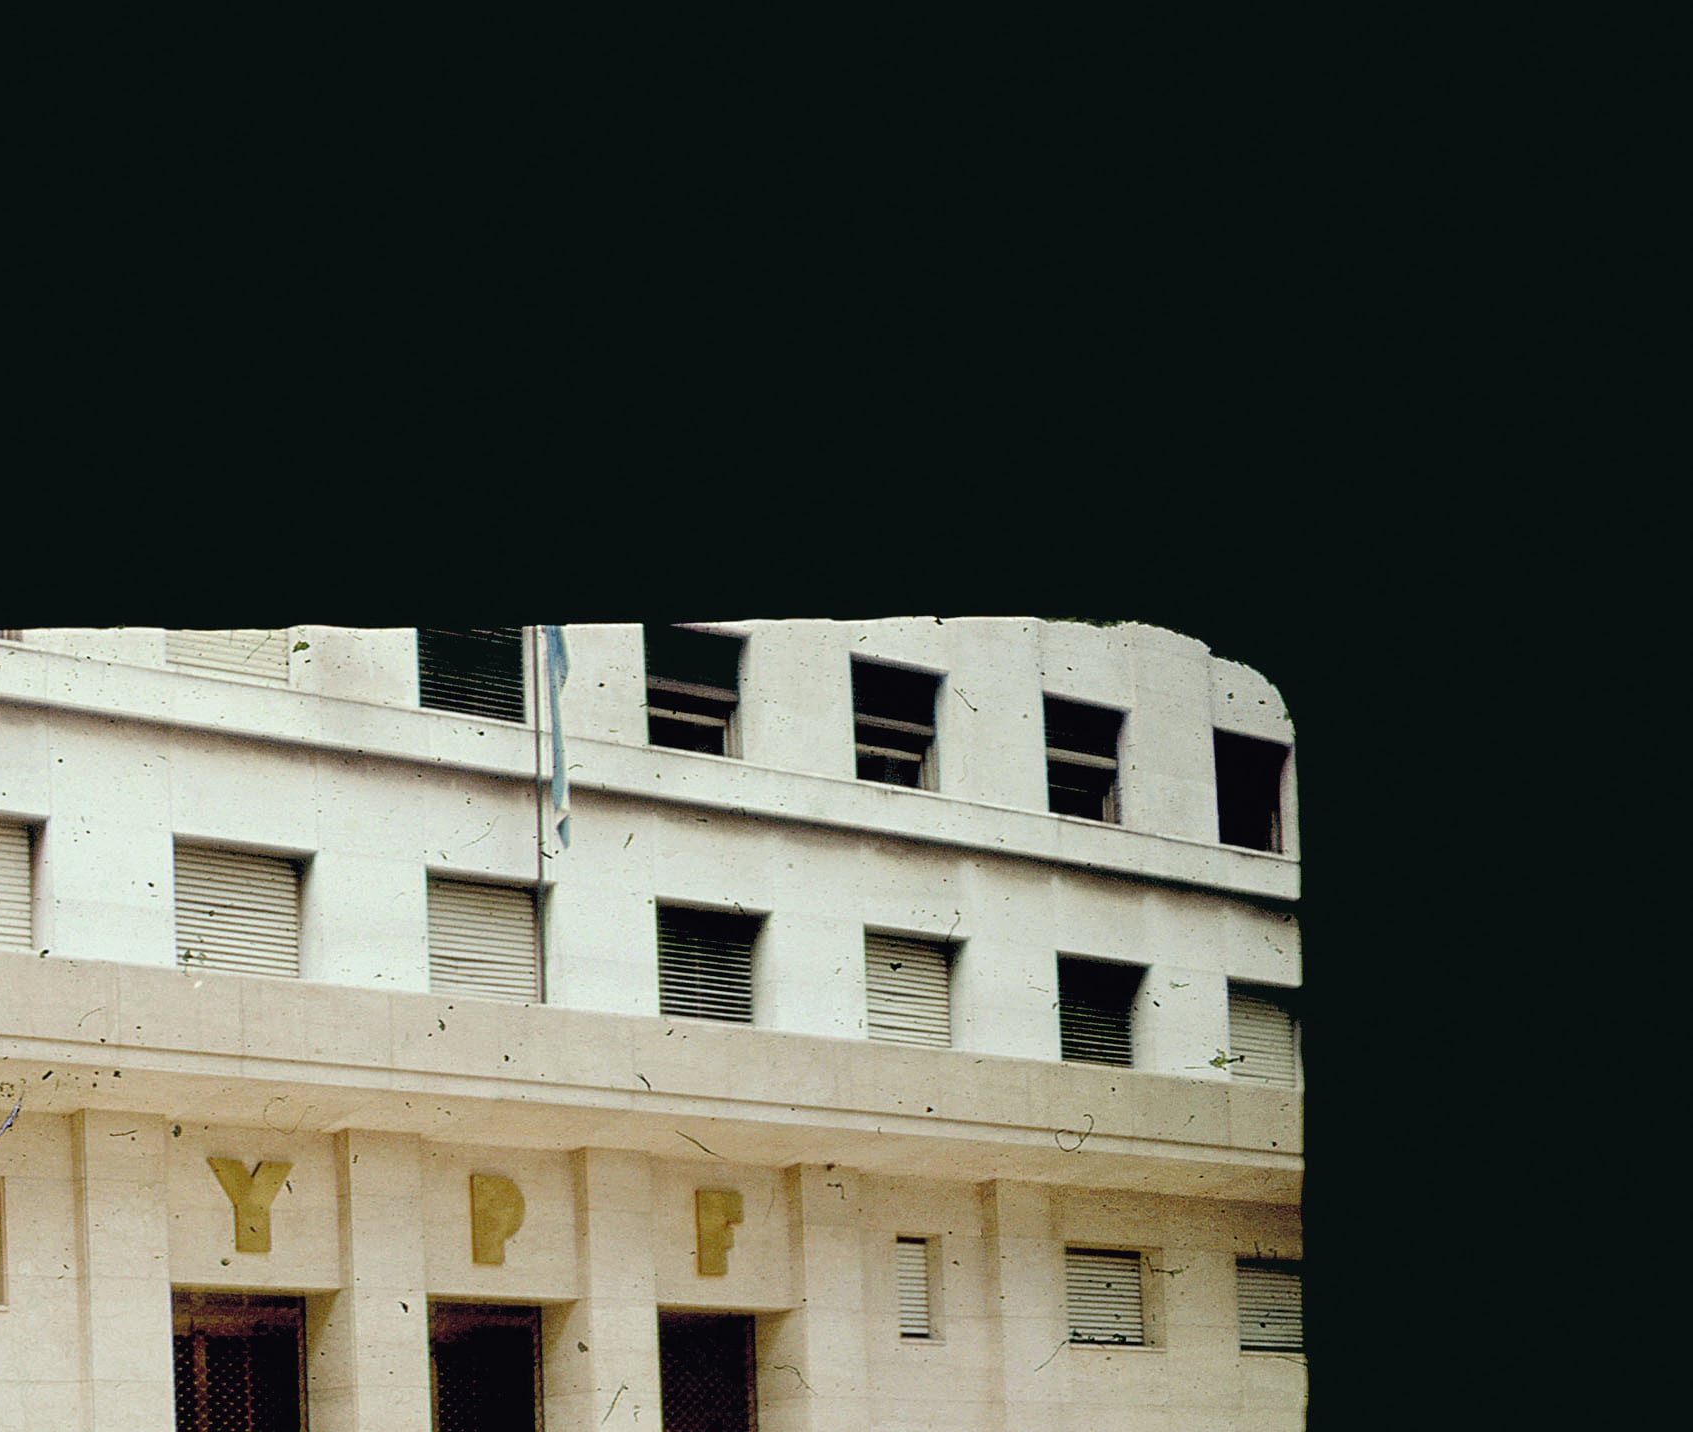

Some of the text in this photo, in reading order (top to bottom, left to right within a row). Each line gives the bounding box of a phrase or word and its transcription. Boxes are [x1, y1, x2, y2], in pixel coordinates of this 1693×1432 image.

[208, 1156, 744, 1277] Y P F
